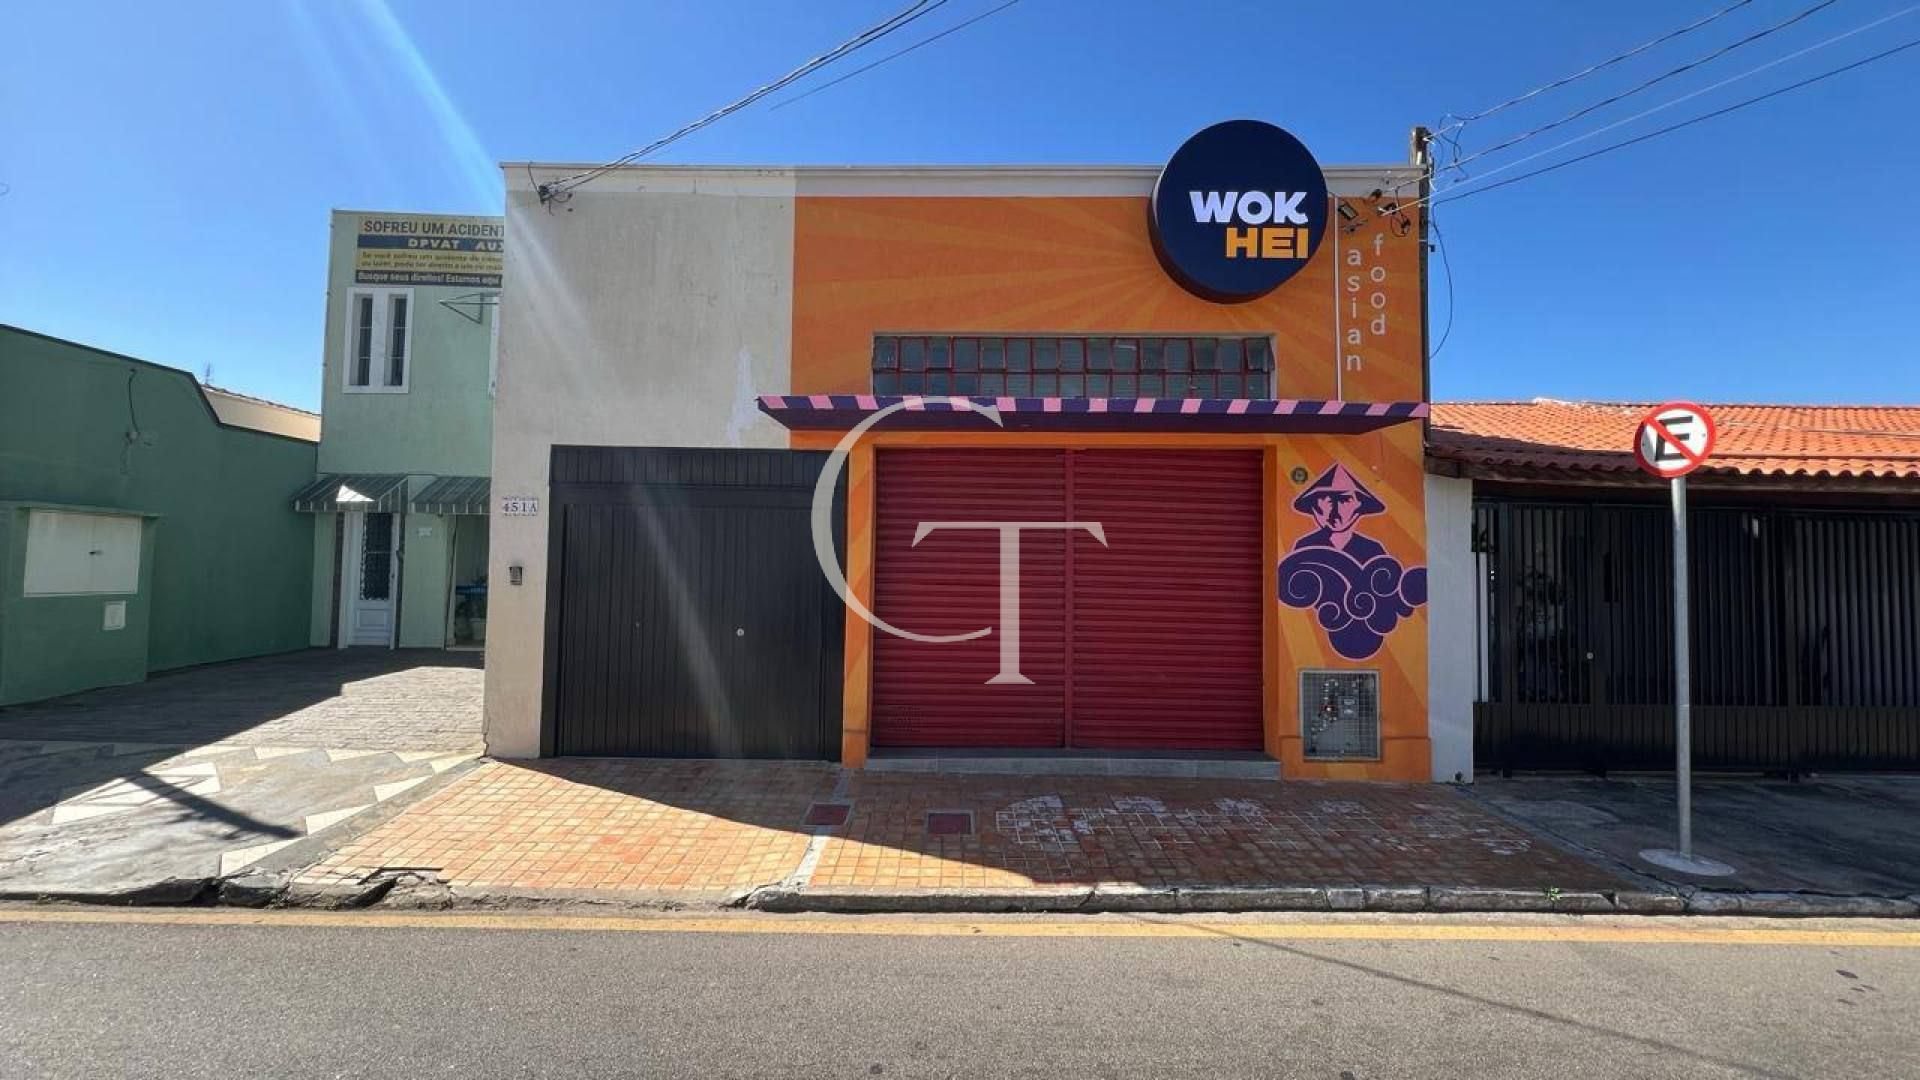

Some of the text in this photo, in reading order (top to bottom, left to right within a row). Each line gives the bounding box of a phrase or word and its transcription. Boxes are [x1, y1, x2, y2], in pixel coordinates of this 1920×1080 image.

[1189, 191, 1309, 224] WOK
[363, 220, 418, 233] SOFREU
[422, 221, 445, 235] UM
[407, 238, 460, 250] DPVAT
[1226, 228, 1308, 259] HEI
[1371, 233, 1386, 335] food
[1347, 249, 1361, 371] asian
[503, 501, 537, 512] 451A
